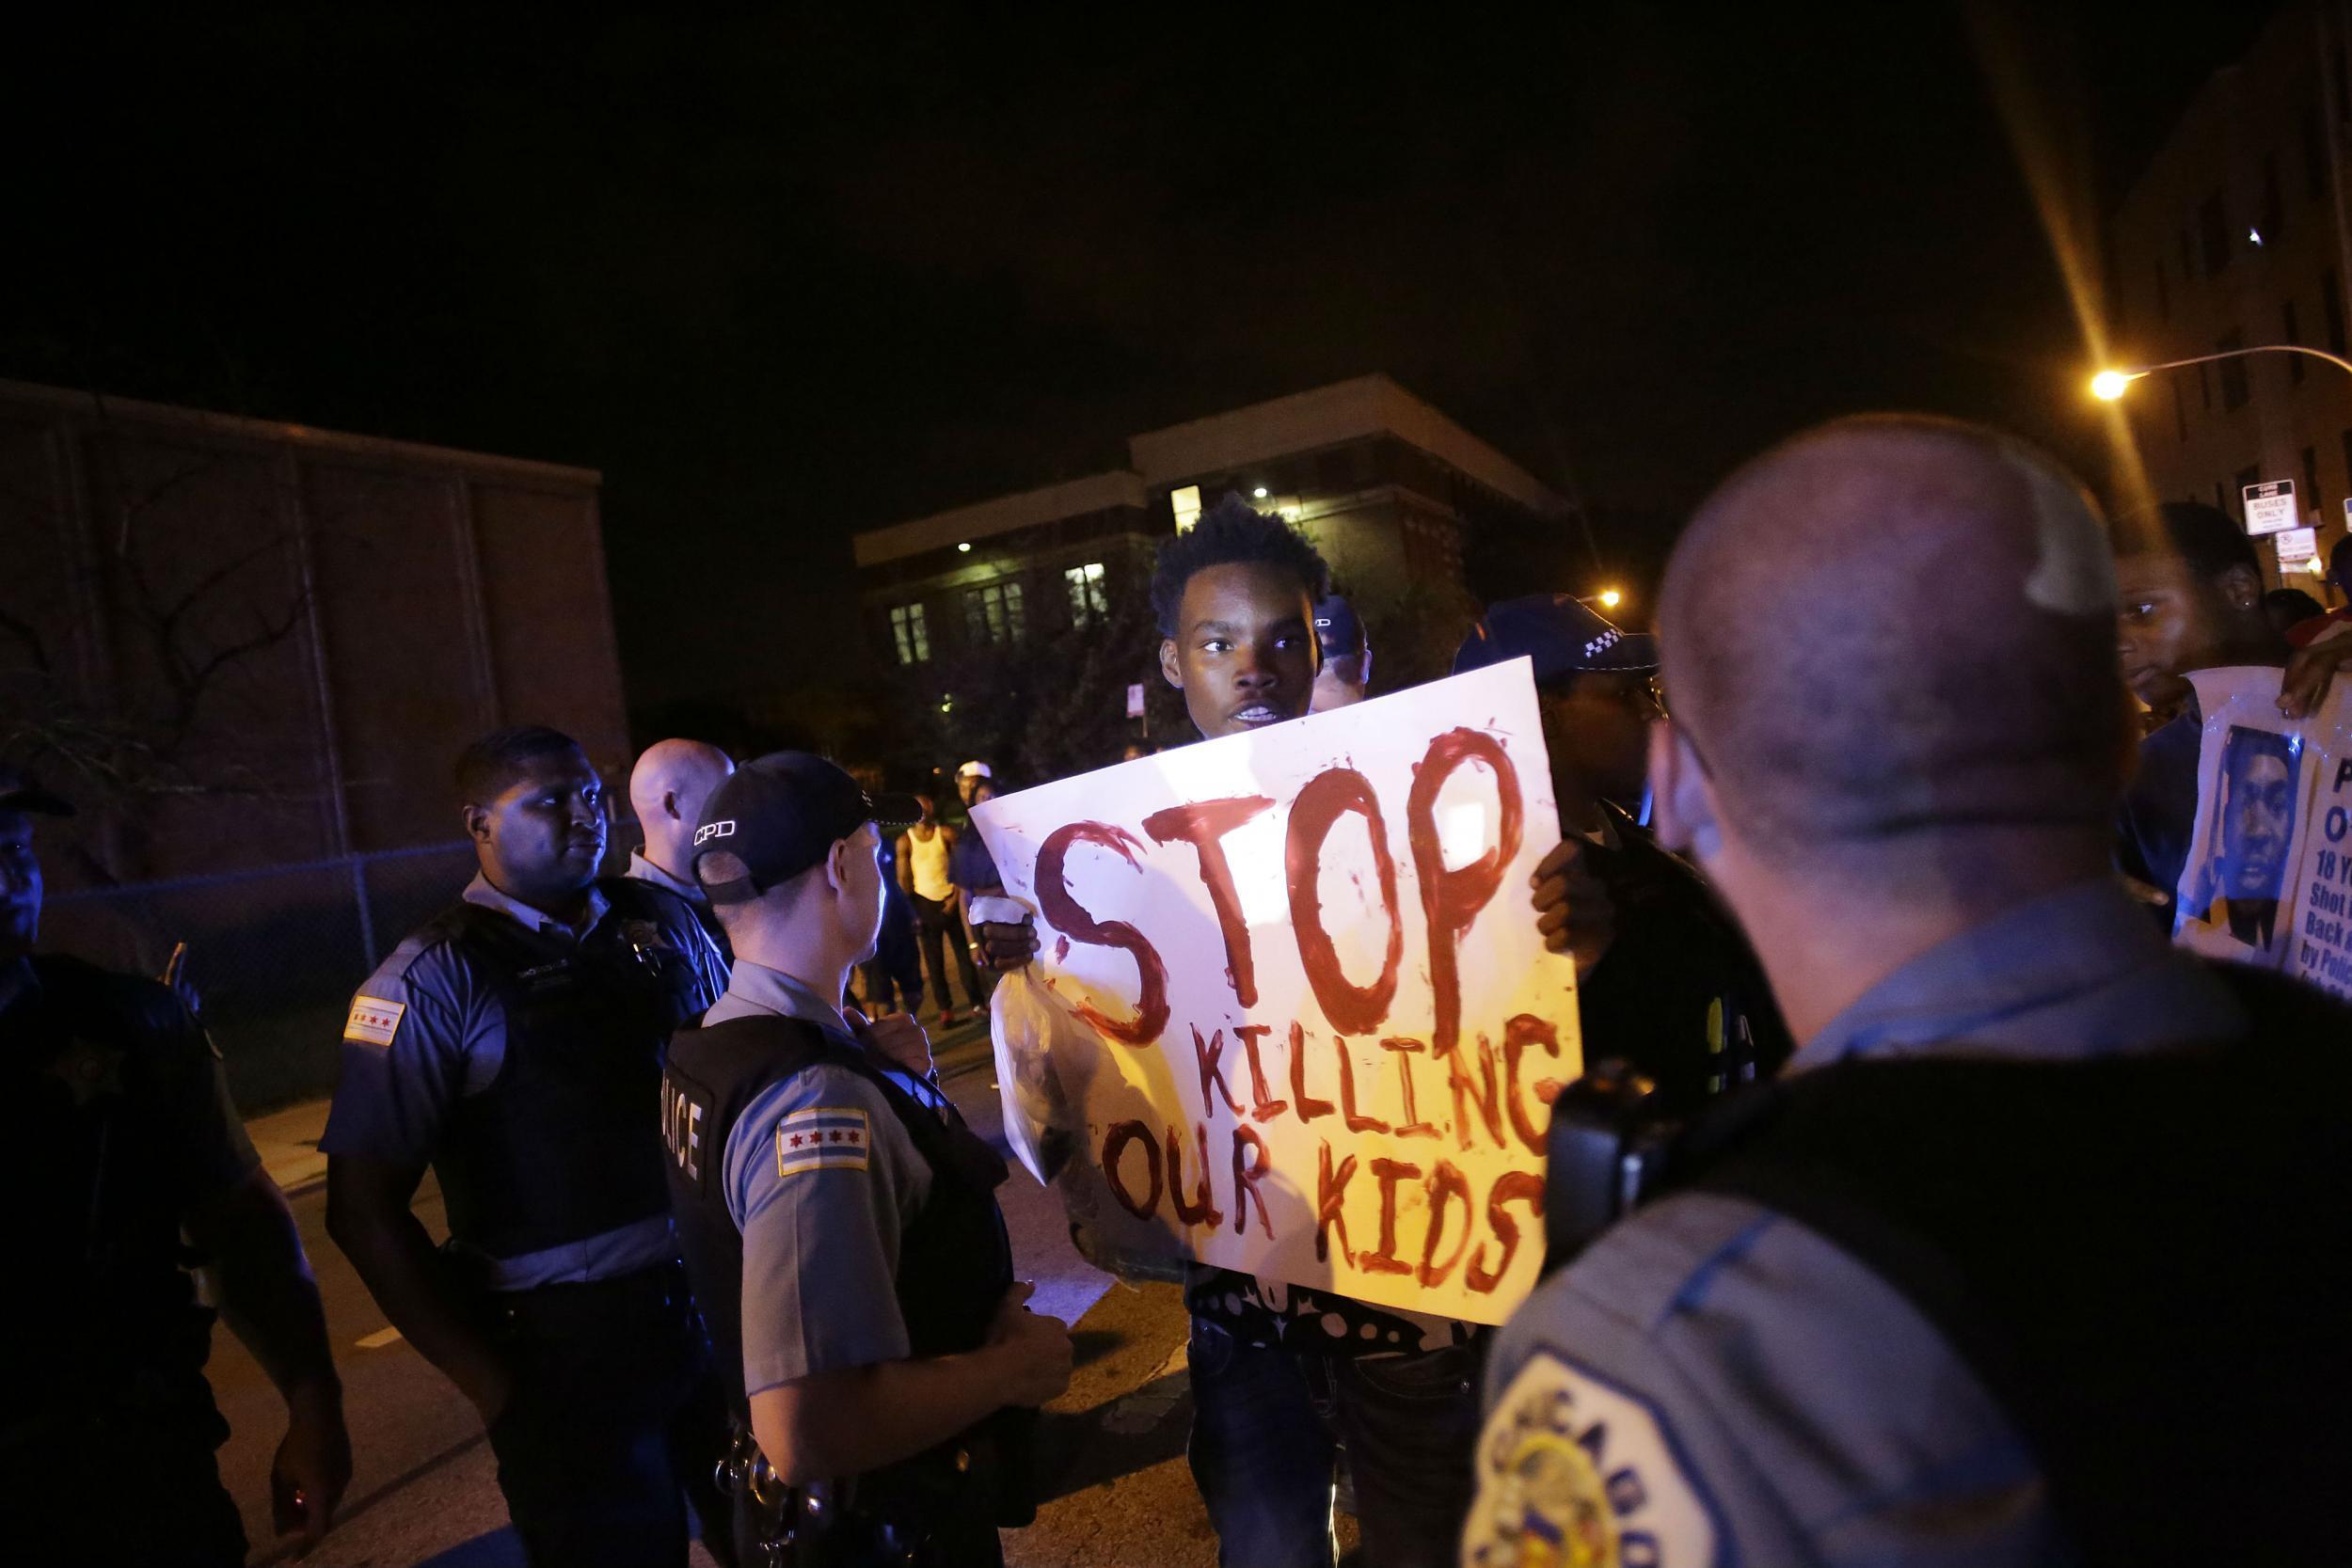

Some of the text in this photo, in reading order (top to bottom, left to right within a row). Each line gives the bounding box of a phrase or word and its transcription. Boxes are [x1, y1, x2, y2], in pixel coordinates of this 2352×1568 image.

[2253, 499, 2287, 510] BUSES
[2257, 508, 2285, 519] ONLY
[693, 820, 736, 847] CPD
[2317, 849, 2336, 880] 18
[1034, 726, 1524, 1060] STOP
[2309, 882, 2345, 917] Shot
[2305, 911, 2344, 947] Back
[2300, 940, 2319, 970] by
[1190, 1013, 1568, 1156] KILLING
[1102, 1119, 1278, 1241] OUR
[1316, 1136, 1546, 1294] KIDS
